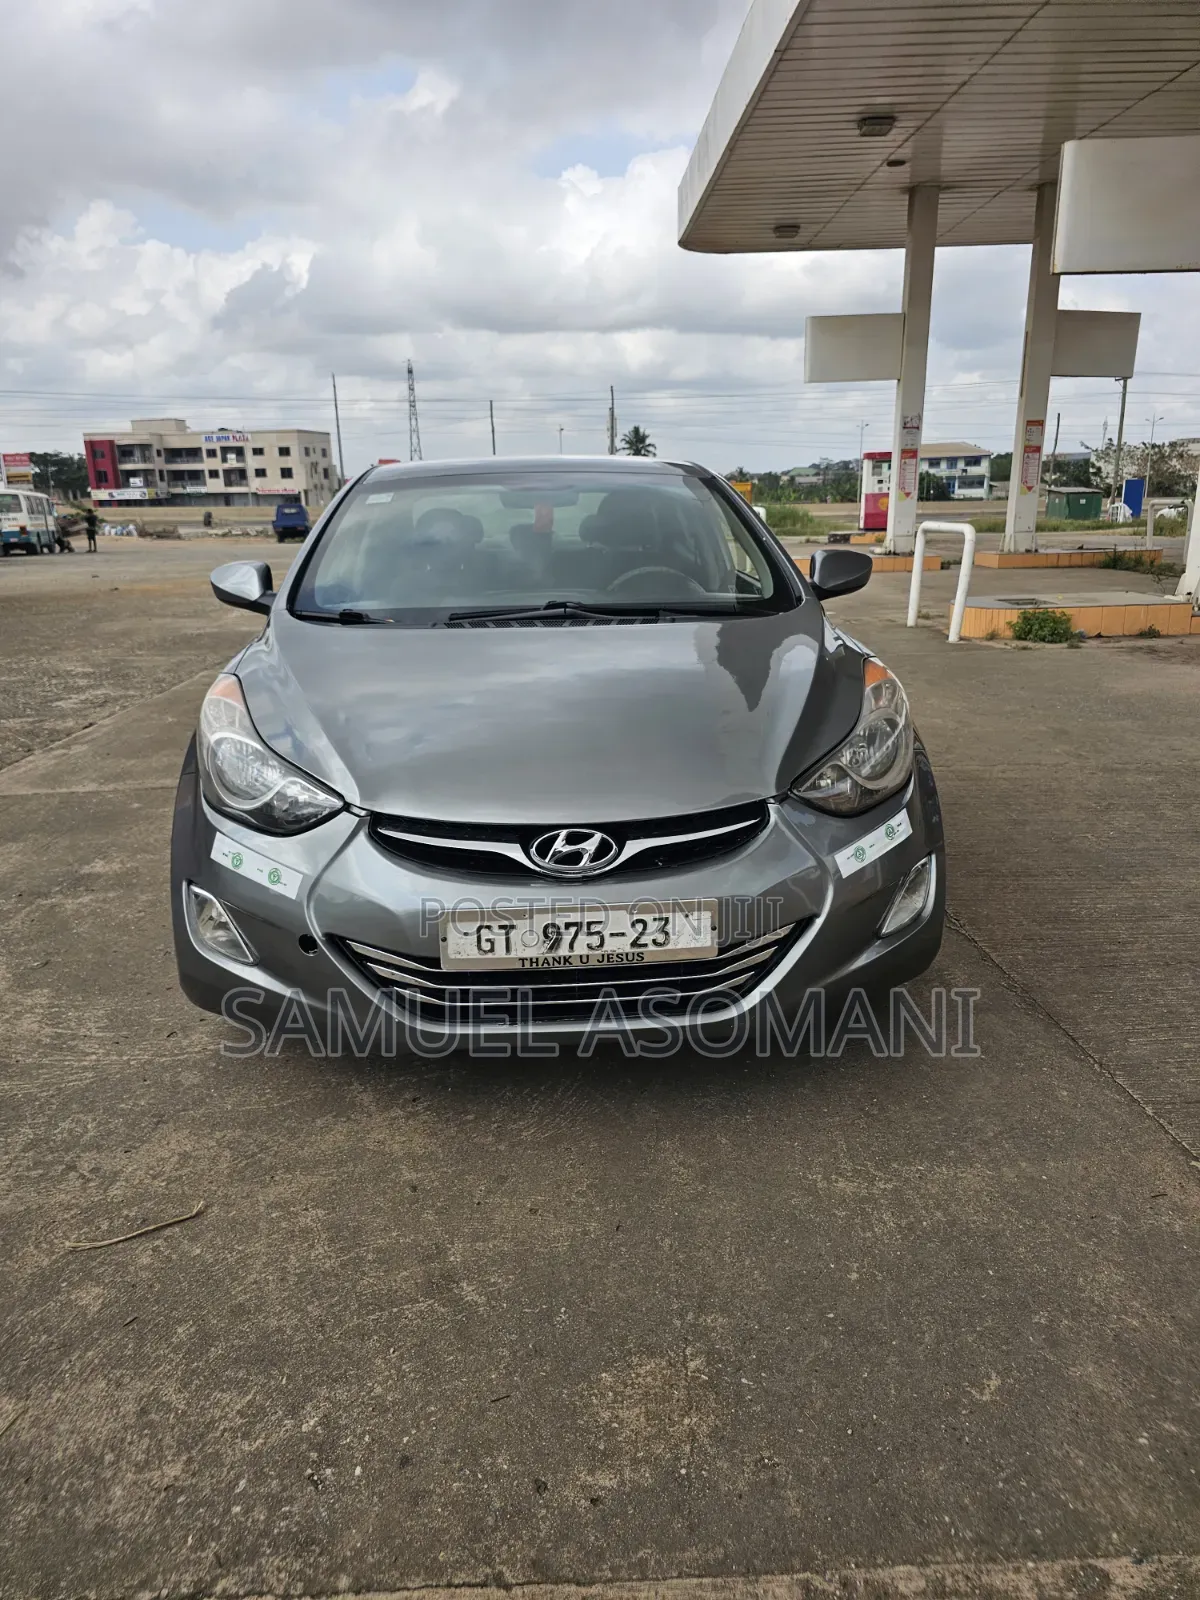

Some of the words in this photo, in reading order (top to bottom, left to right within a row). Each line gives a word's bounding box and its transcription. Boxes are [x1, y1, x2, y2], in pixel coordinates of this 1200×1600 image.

[476, 924, 517, 955] GT
[541, 916, 671, 955] 975-23
[518, 955, 573, 968] THANK
[579, 954, 590, 965] U
[596, 951, 645, 964] JESUS
